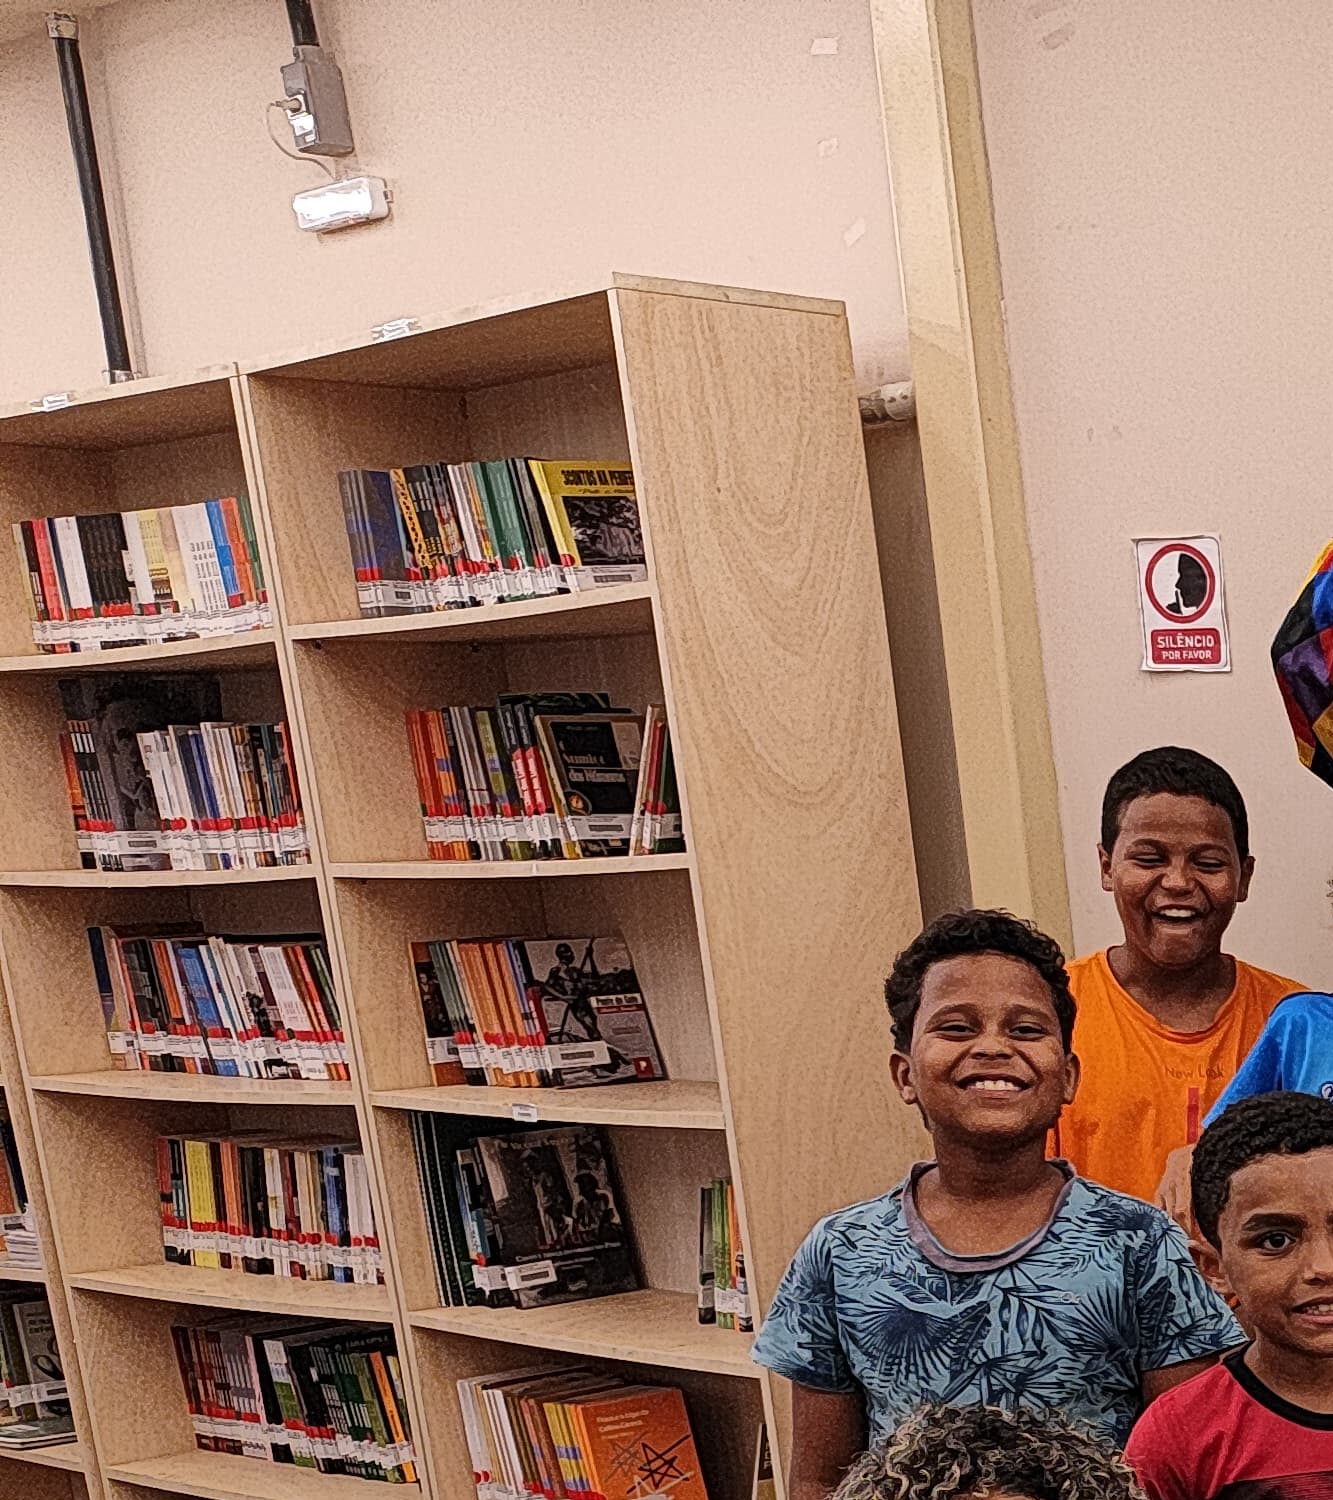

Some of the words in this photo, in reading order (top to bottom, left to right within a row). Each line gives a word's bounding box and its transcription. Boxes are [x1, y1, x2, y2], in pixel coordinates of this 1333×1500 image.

[1157, 633, 1214, 648] SILÊNCIO
[1162, 650, 1181, 660] POR
[1182, 650, 1212, 660] FAVOR
